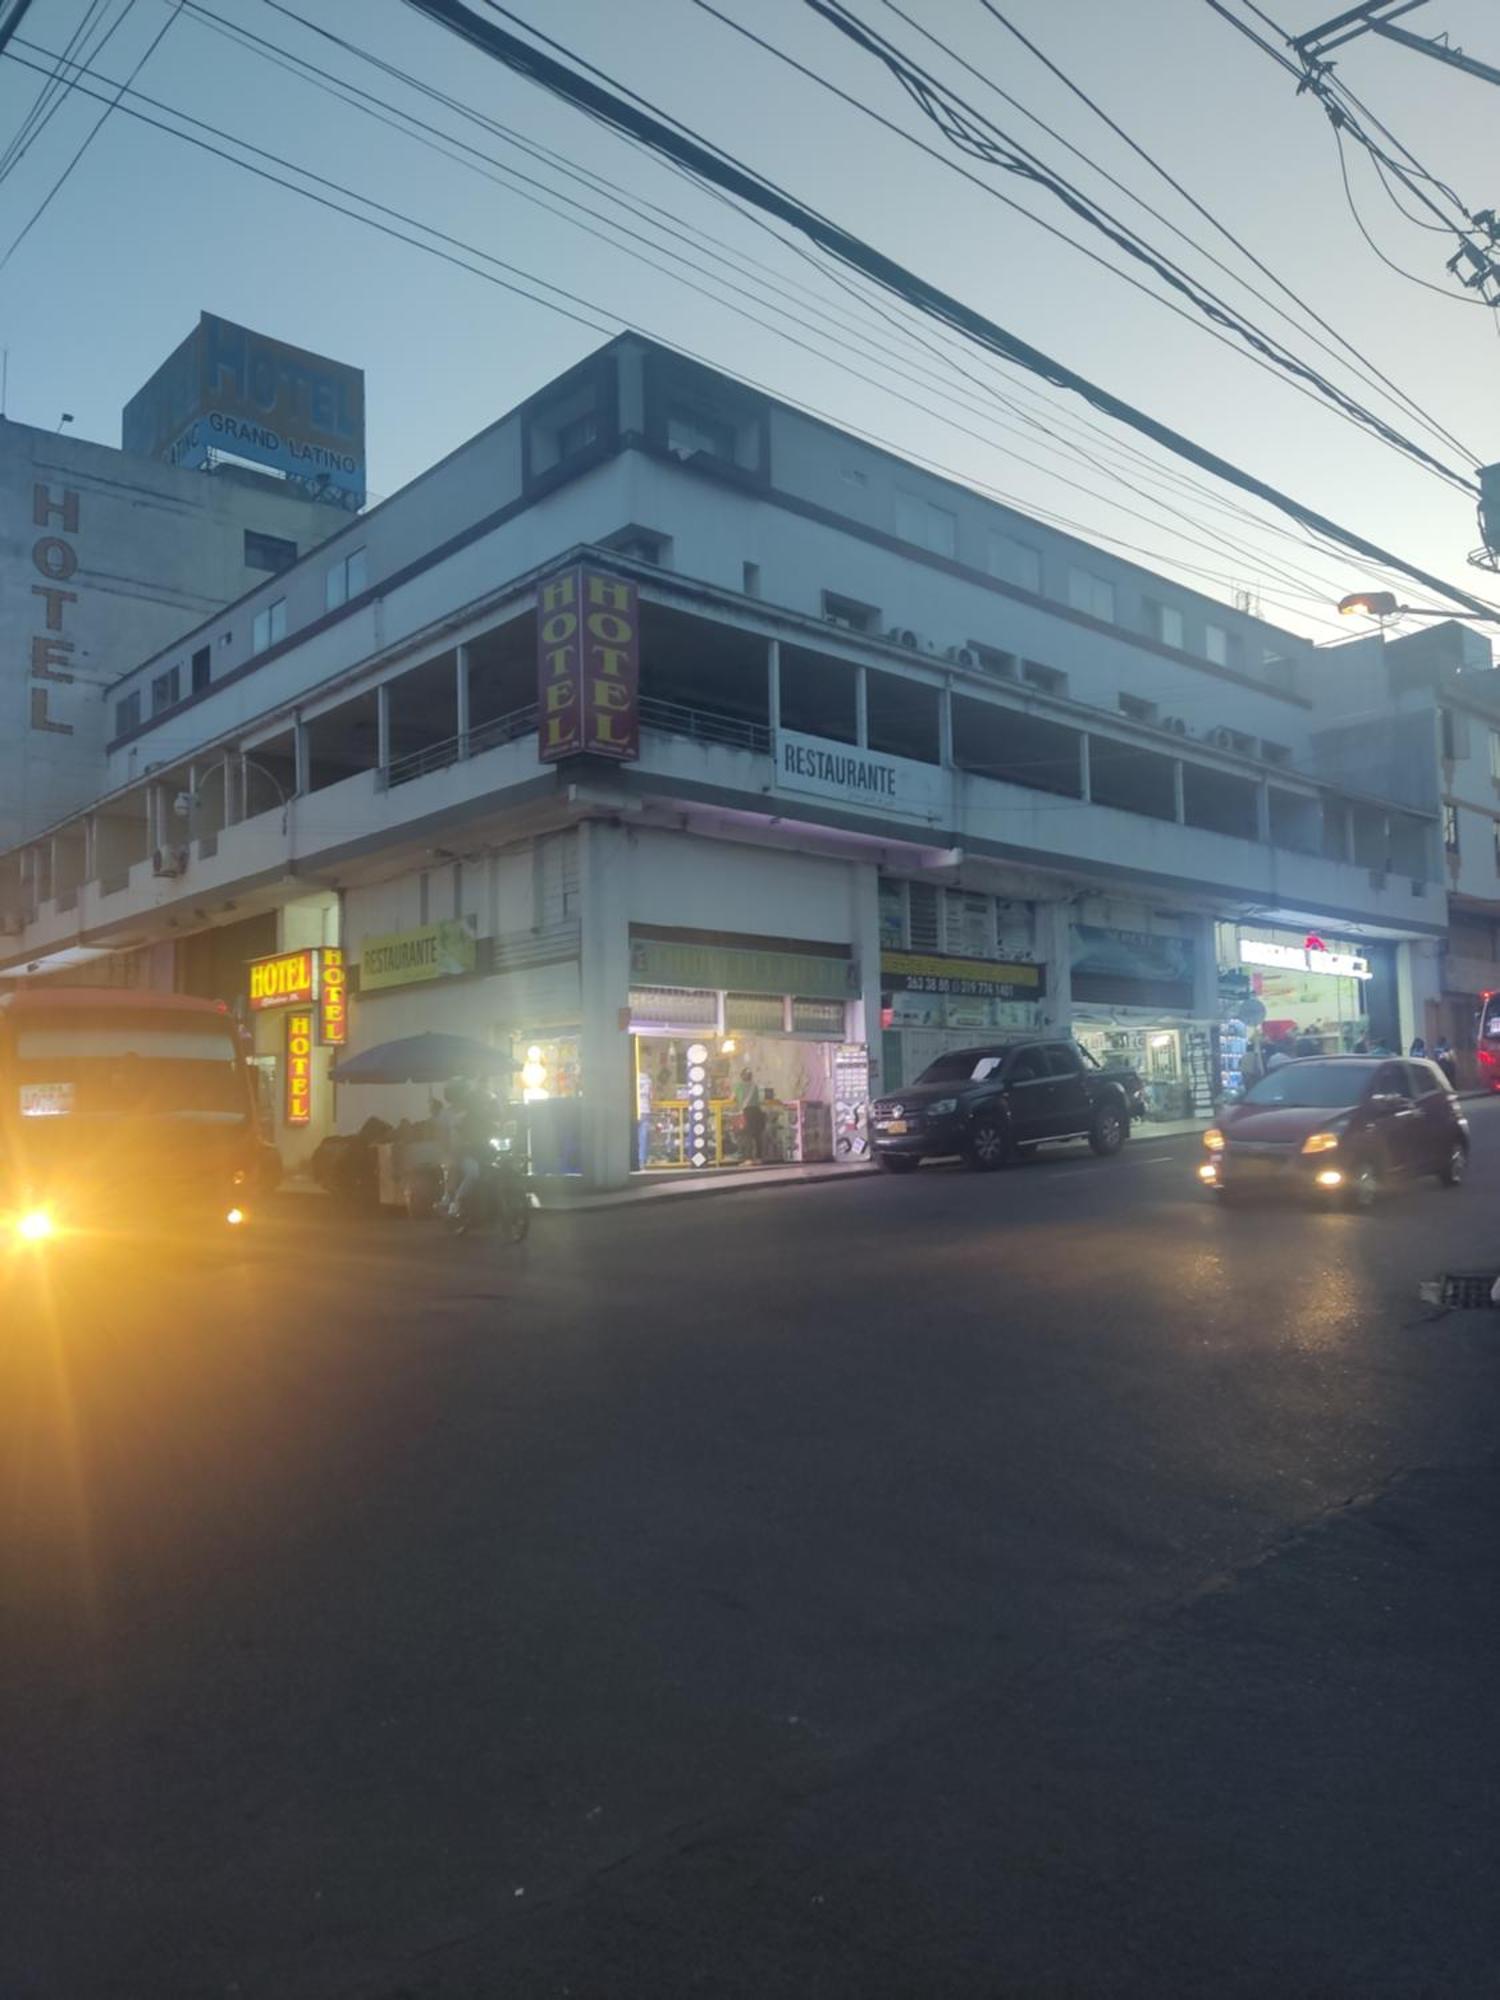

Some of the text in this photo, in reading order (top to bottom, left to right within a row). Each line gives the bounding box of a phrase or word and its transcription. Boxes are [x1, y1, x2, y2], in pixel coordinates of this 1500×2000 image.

[207, 320, 353, 440] HOTEL
[209, 413, 356, 474] GRAND LATINO
[32, 483, 80, 735] HOTEL
[542, 575, 577, 745] HOTEL
[586, 576, 632, 744] HOTEL
[785, 744, 895, 796] RESTAURANTE
[251, 955, 310, 998] HOTEL
[323, 950, 344, 1040] HOTEL
[365, 936, 436, 974] RESTAURANTE
[289, 1017, 310, 1116] HOTEL
